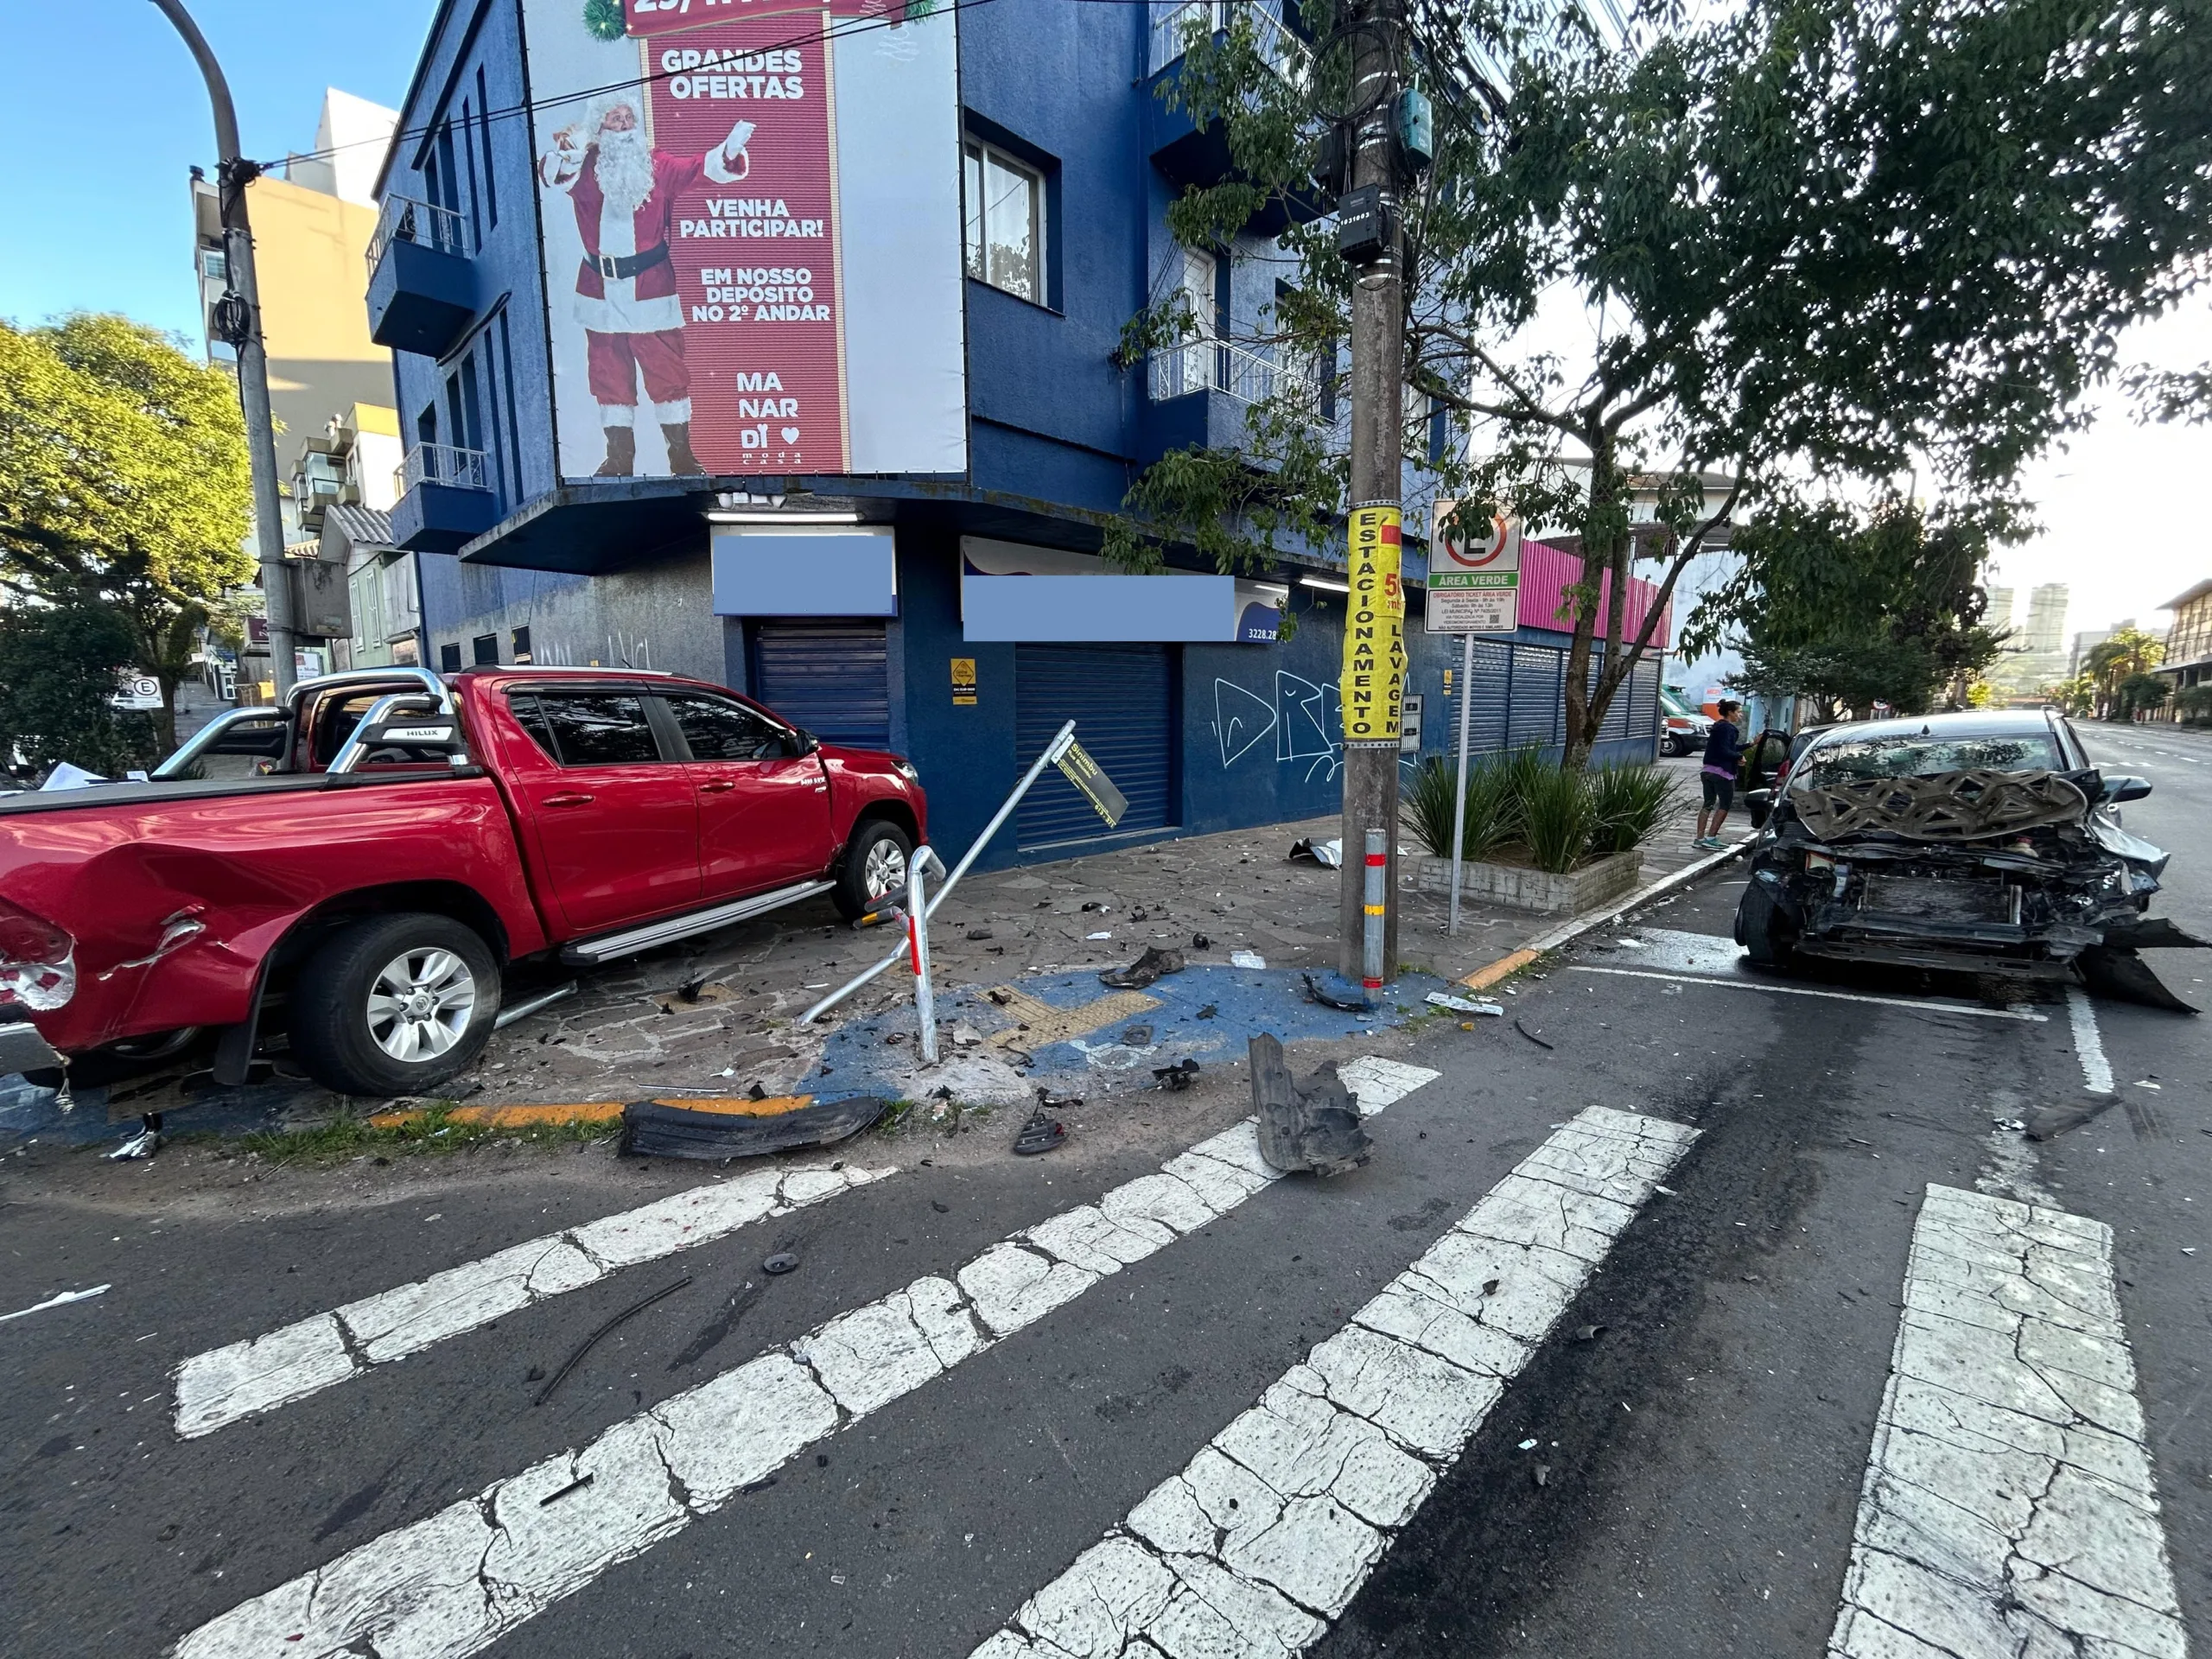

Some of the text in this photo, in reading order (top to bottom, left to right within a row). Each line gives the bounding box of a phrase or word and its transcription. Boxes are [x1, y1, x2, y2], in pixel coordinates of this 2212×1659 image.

[661, 49, 803, 73] GRANDES
[669, 75, 804, 99] OFERTAS
[705, 199, 791, 218] VENHA
[680, 219, 824, 238] PARTICIPAR!
[701, 268, 812, 285] EM NOSSO
[706, 283, 814, 303] DEPÓSITO
[691, 305, 831, 322] NO 2º ANDAR
[736, 372, 785, 392] MA
[739, 398, 798, 418] NAR
[1439, 574, 1509, 586] ÁREA VERDE
[1352, 512, 1376, 734] ESTACIONAMENTO
[1249, 628, 1277, 640] 3228.28
[141, 682, 151, 692] E
[1386, 625, 1402, 734] LAVAGEM
[1071, 743, 1098, 776] Sinimbu
